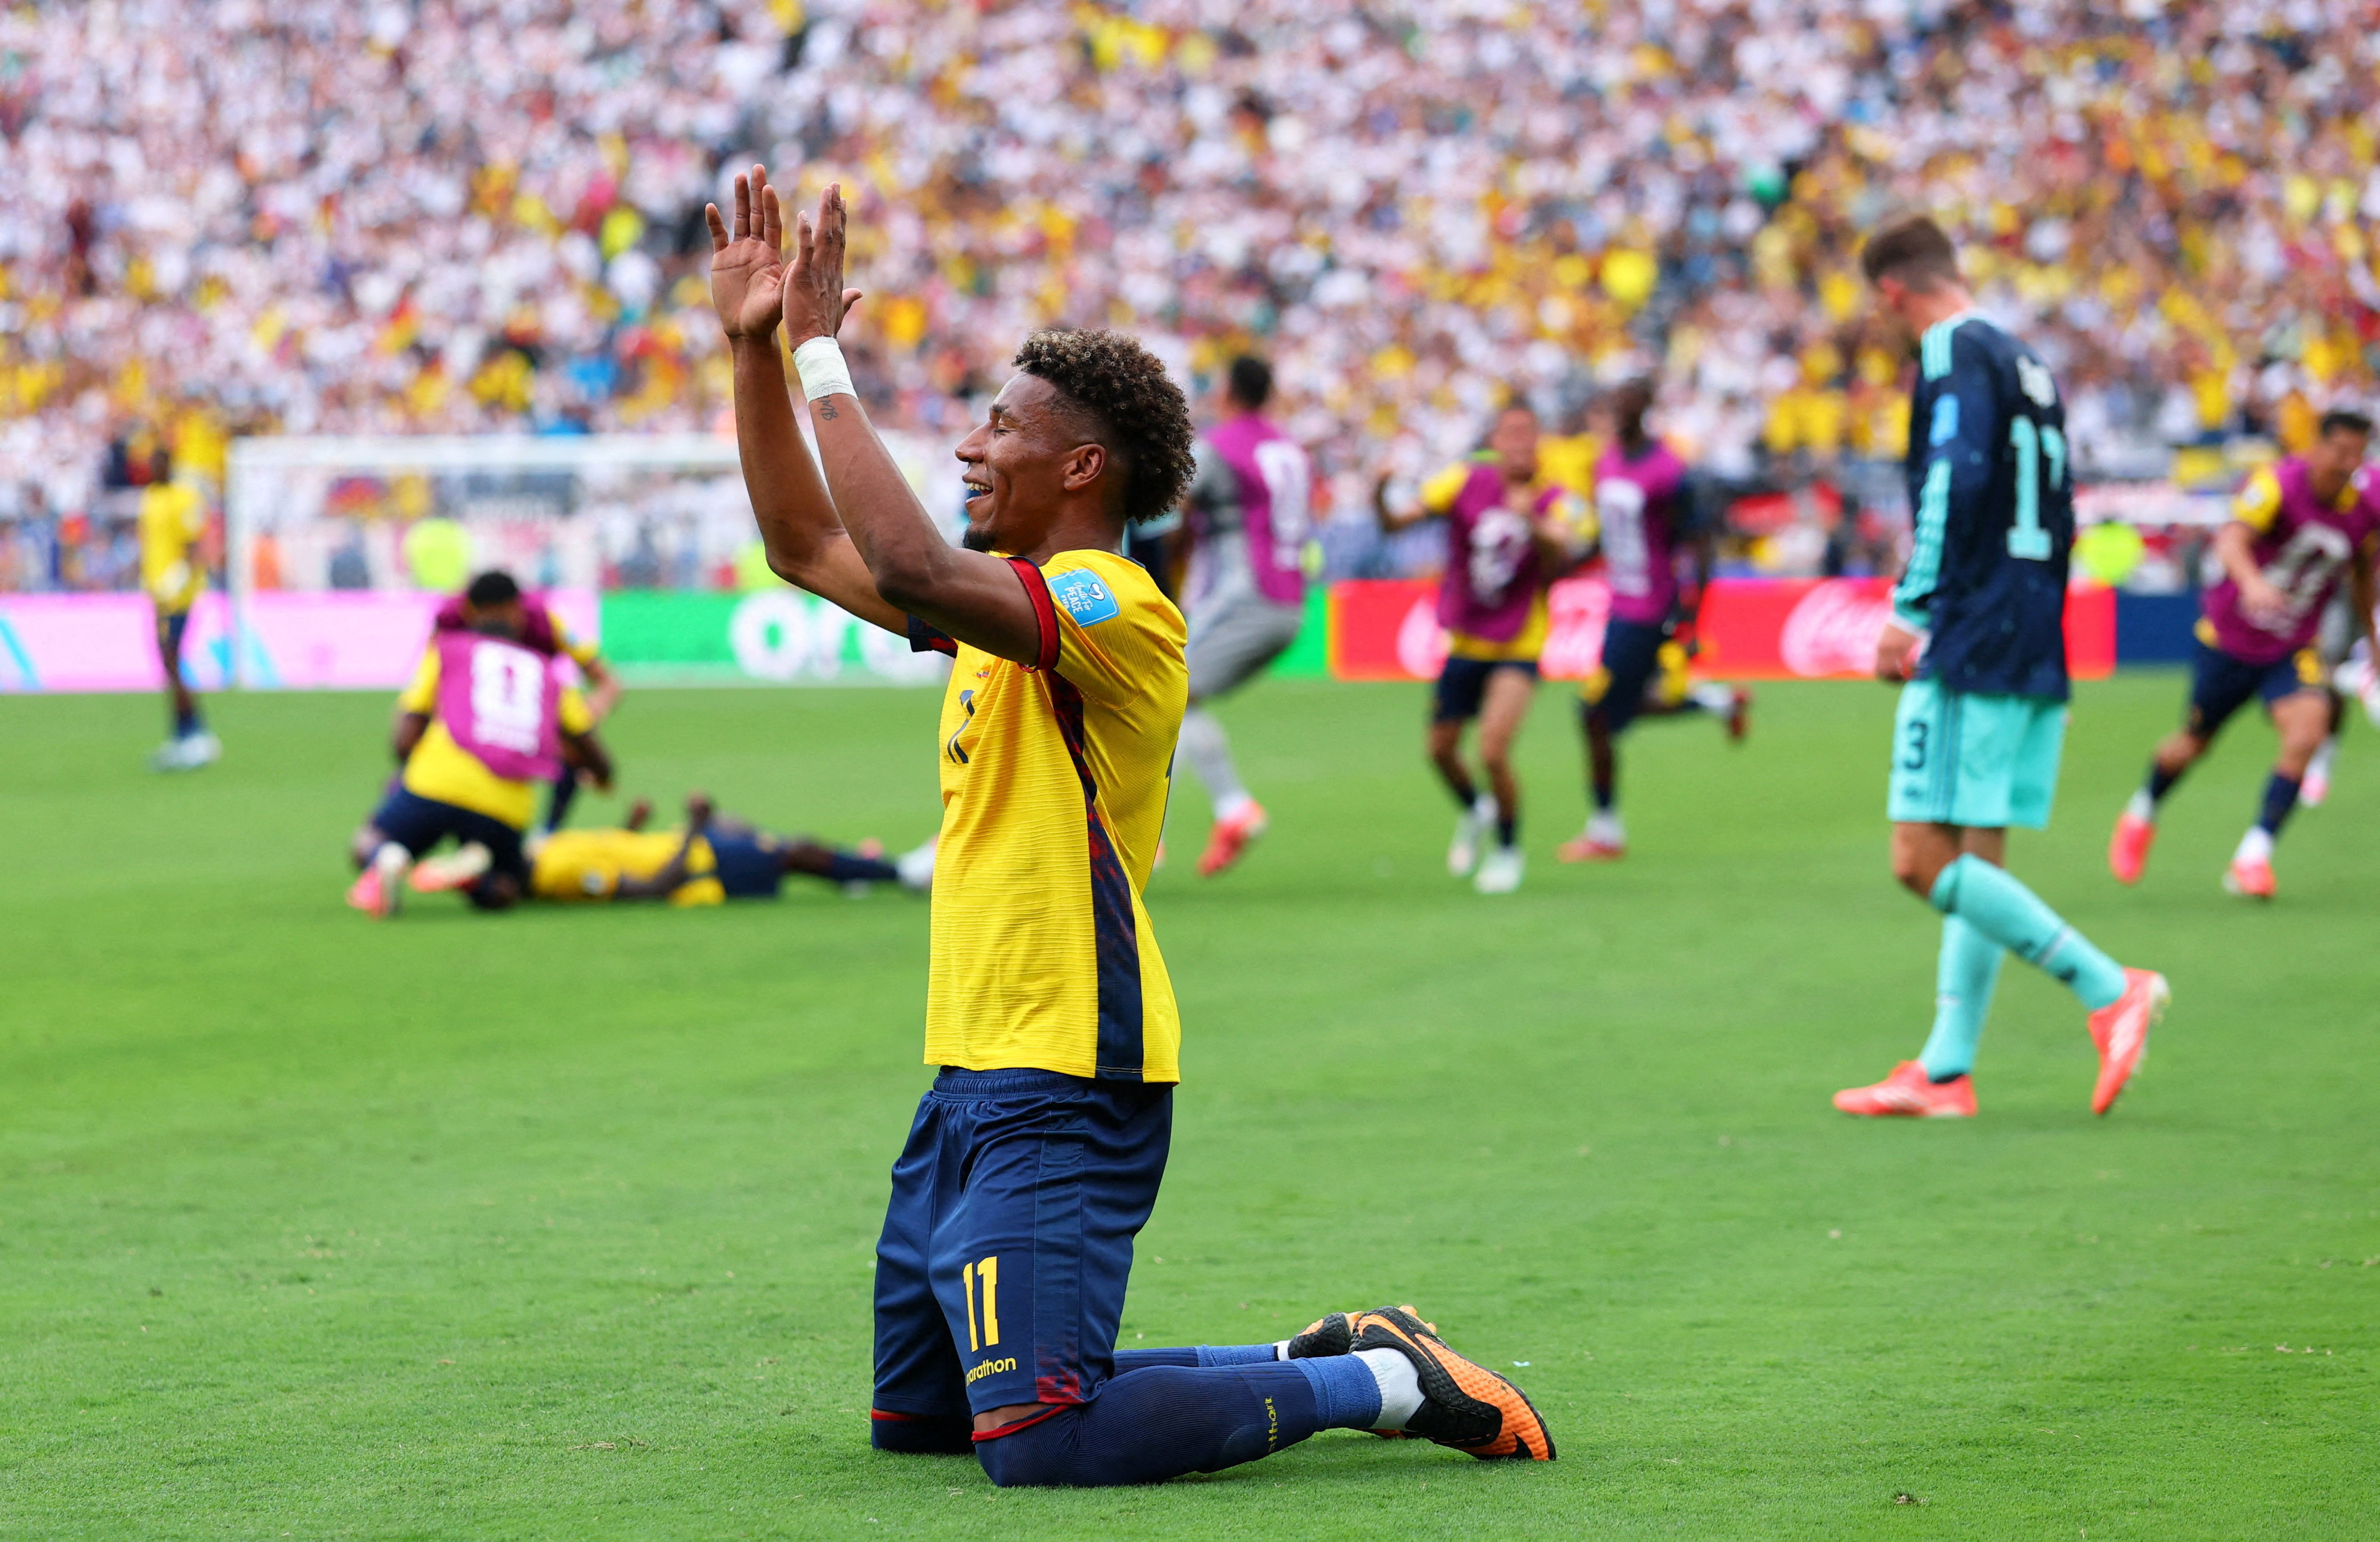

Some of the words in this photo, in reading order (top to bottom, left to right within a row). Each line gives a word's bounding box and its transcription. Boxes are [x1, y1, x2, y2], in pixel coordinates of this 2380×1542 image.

[1064, 586, 1083, 614] PEACE
[1081, 599, 1094, 611] For
[963, 1256, 999, 1352] 11
